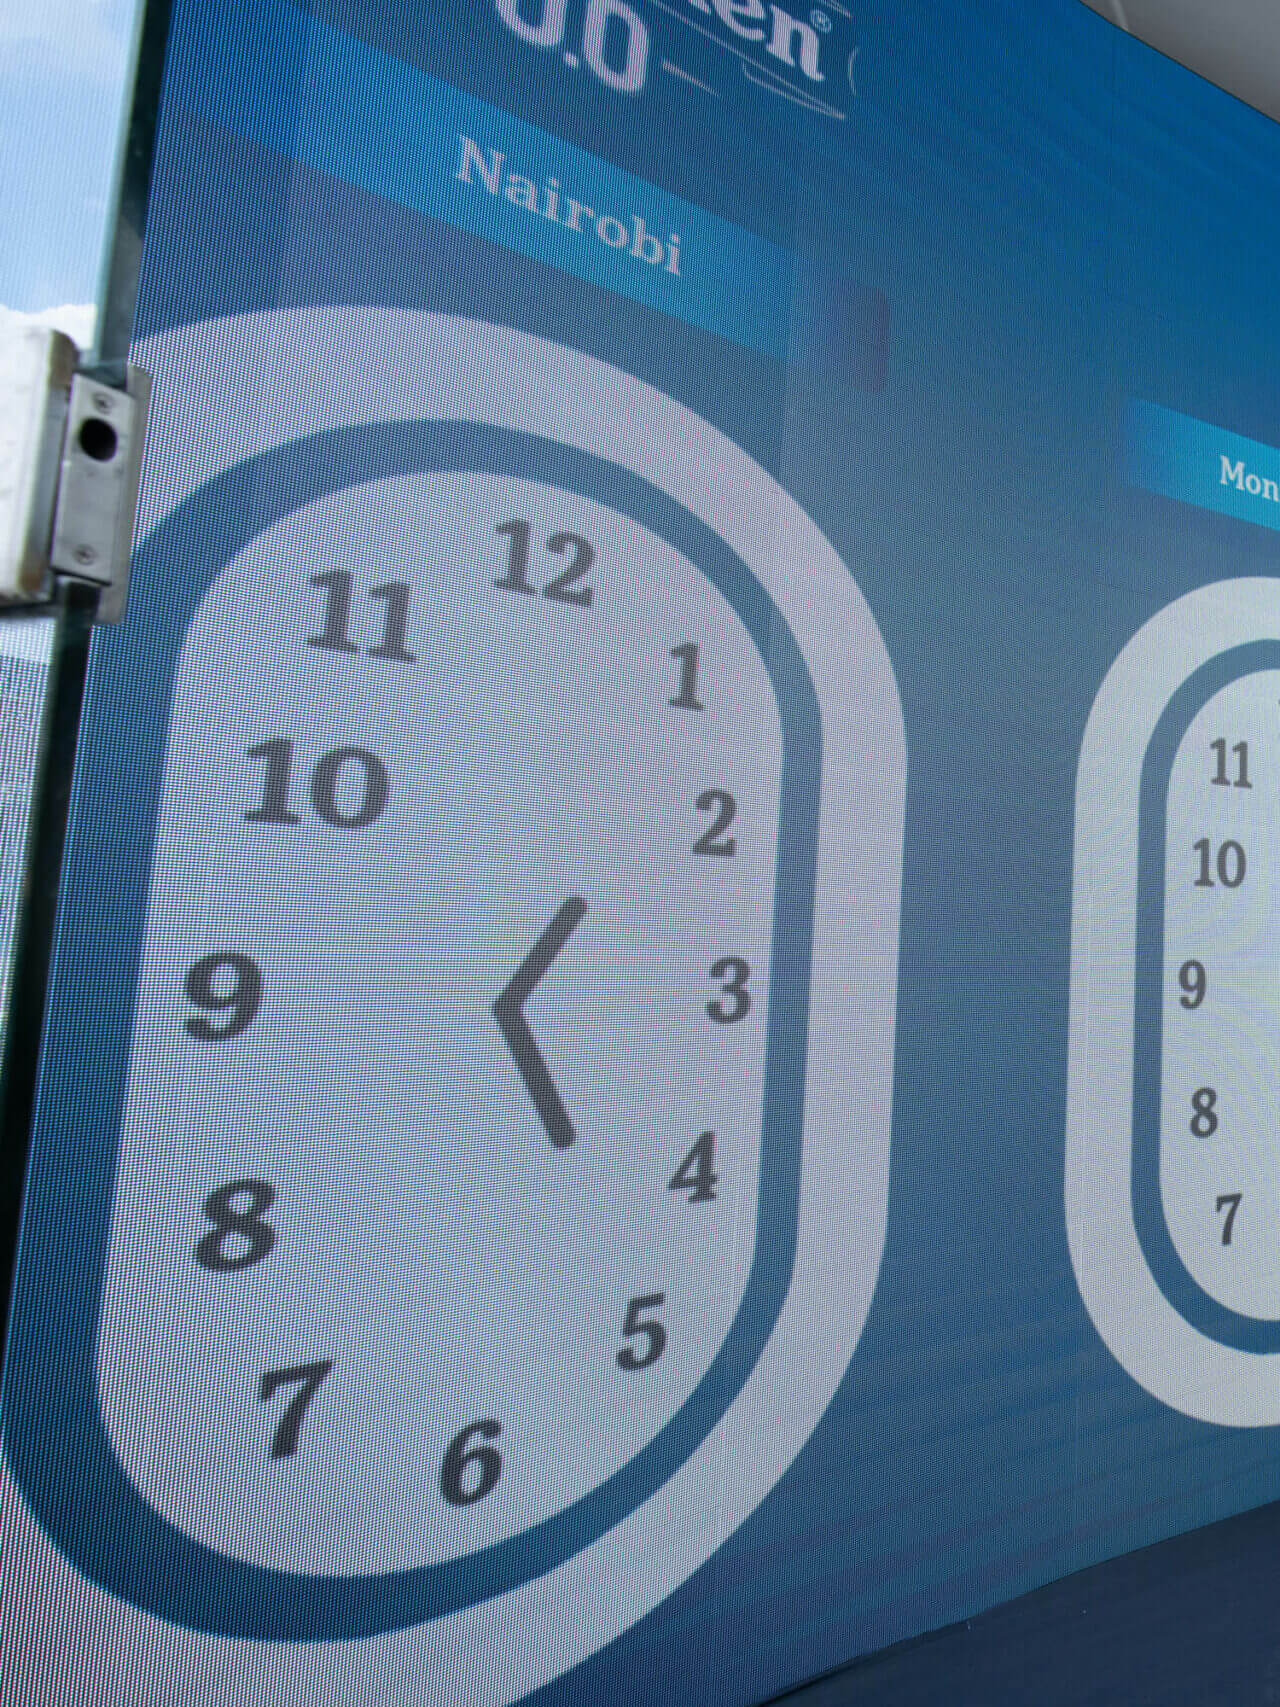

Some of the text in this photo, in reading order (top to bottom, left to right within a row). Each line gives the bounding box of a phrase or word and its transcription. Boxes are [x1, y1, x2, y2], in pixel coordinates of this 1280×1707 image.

[455, 135, 681, 276] Nairobi
[493, 519, 595, 608] 12
[306, 569, 416, 664] 11
[669, 642, 704, 711] 1
[243, 738, 389, 830] 10
[1210, 737, 1252, 789] 11
[692, 789, 737, 858] 2
[1193, 837, 1247, 889] 10
[184, 952, 263, 1043] 9
[706, 956, 751, 1025] 3
[1178, 959, 1207, 1011] 9
[1189, 1087, 1219, 1139] 8
[668, 1131, 718, 1203] 4
[194, 1179, 276, 1273] 8
[1215, 1193, 1242, 1246] 7
[616, 1293, 667, 1372] 5
[259, 1360, 333, 1460] 7
[439, 1419, 502, 1507] 6
